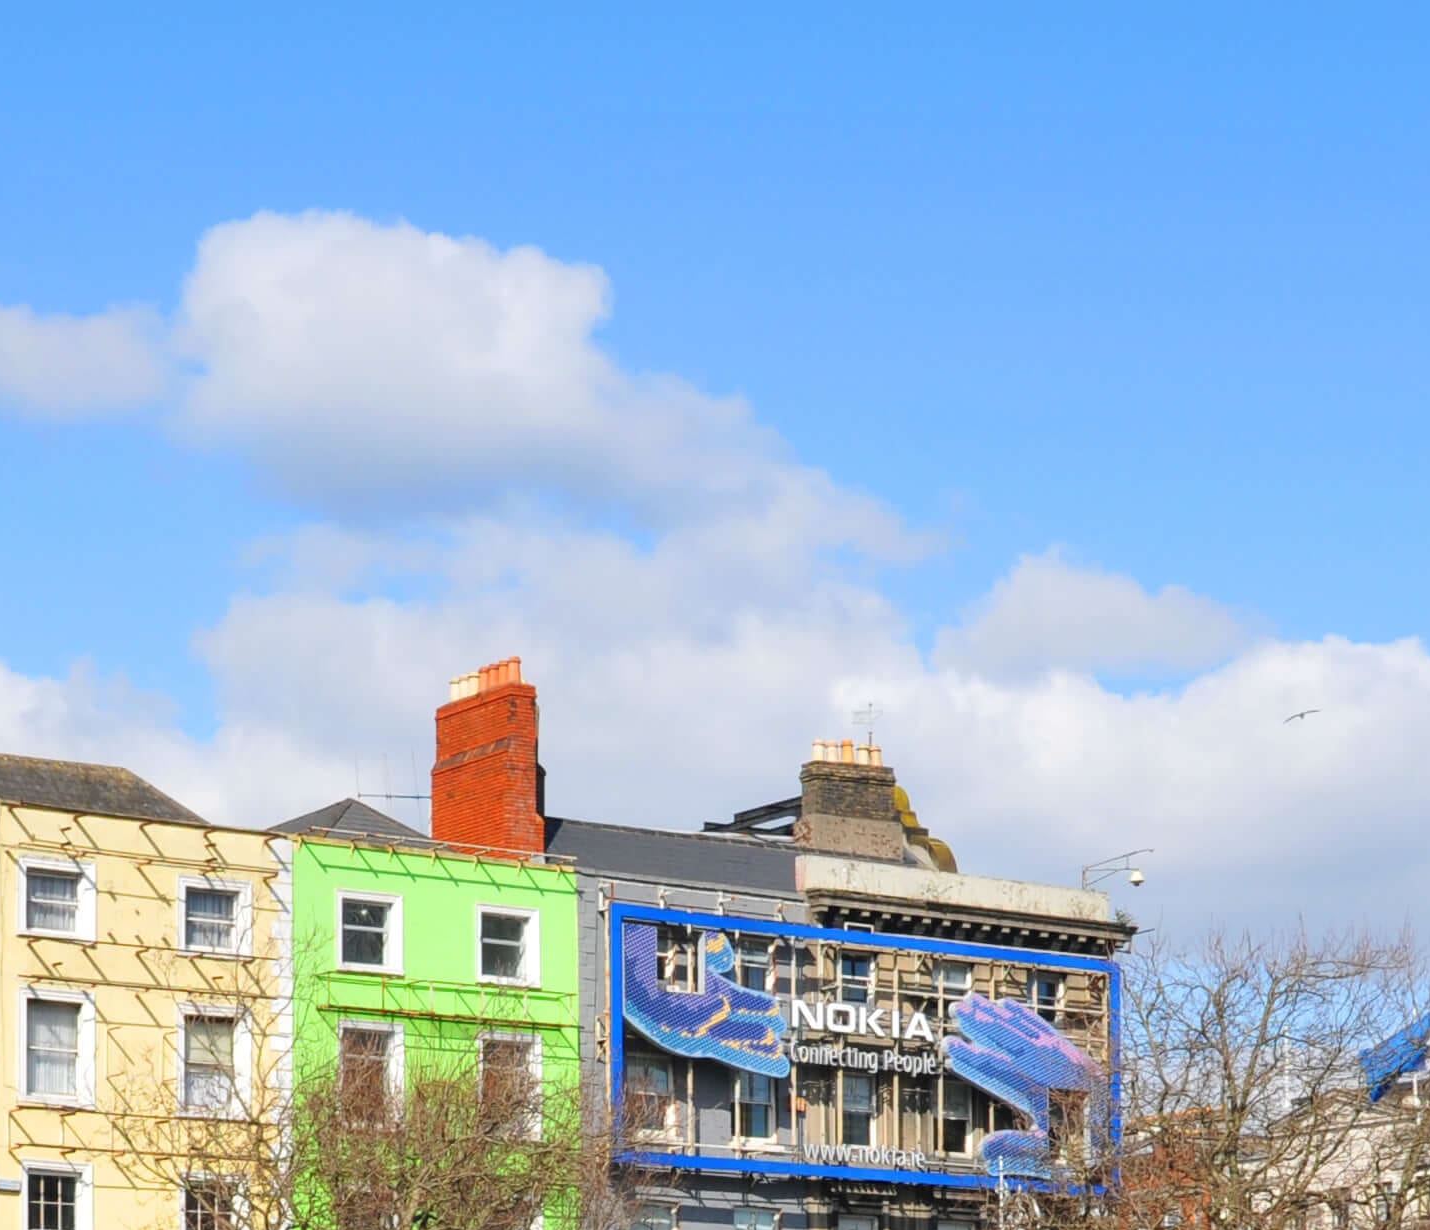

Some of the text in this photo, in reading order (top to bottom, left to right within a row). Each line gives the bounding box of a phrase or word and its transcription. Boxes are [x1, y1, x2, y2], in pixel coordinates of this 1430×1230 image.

[791, 999, 934, 1042] NOKIA
[790, 1042, 937, 1077] Connecting People
[803, 1143, 926, 1168] www.nokia.ie
